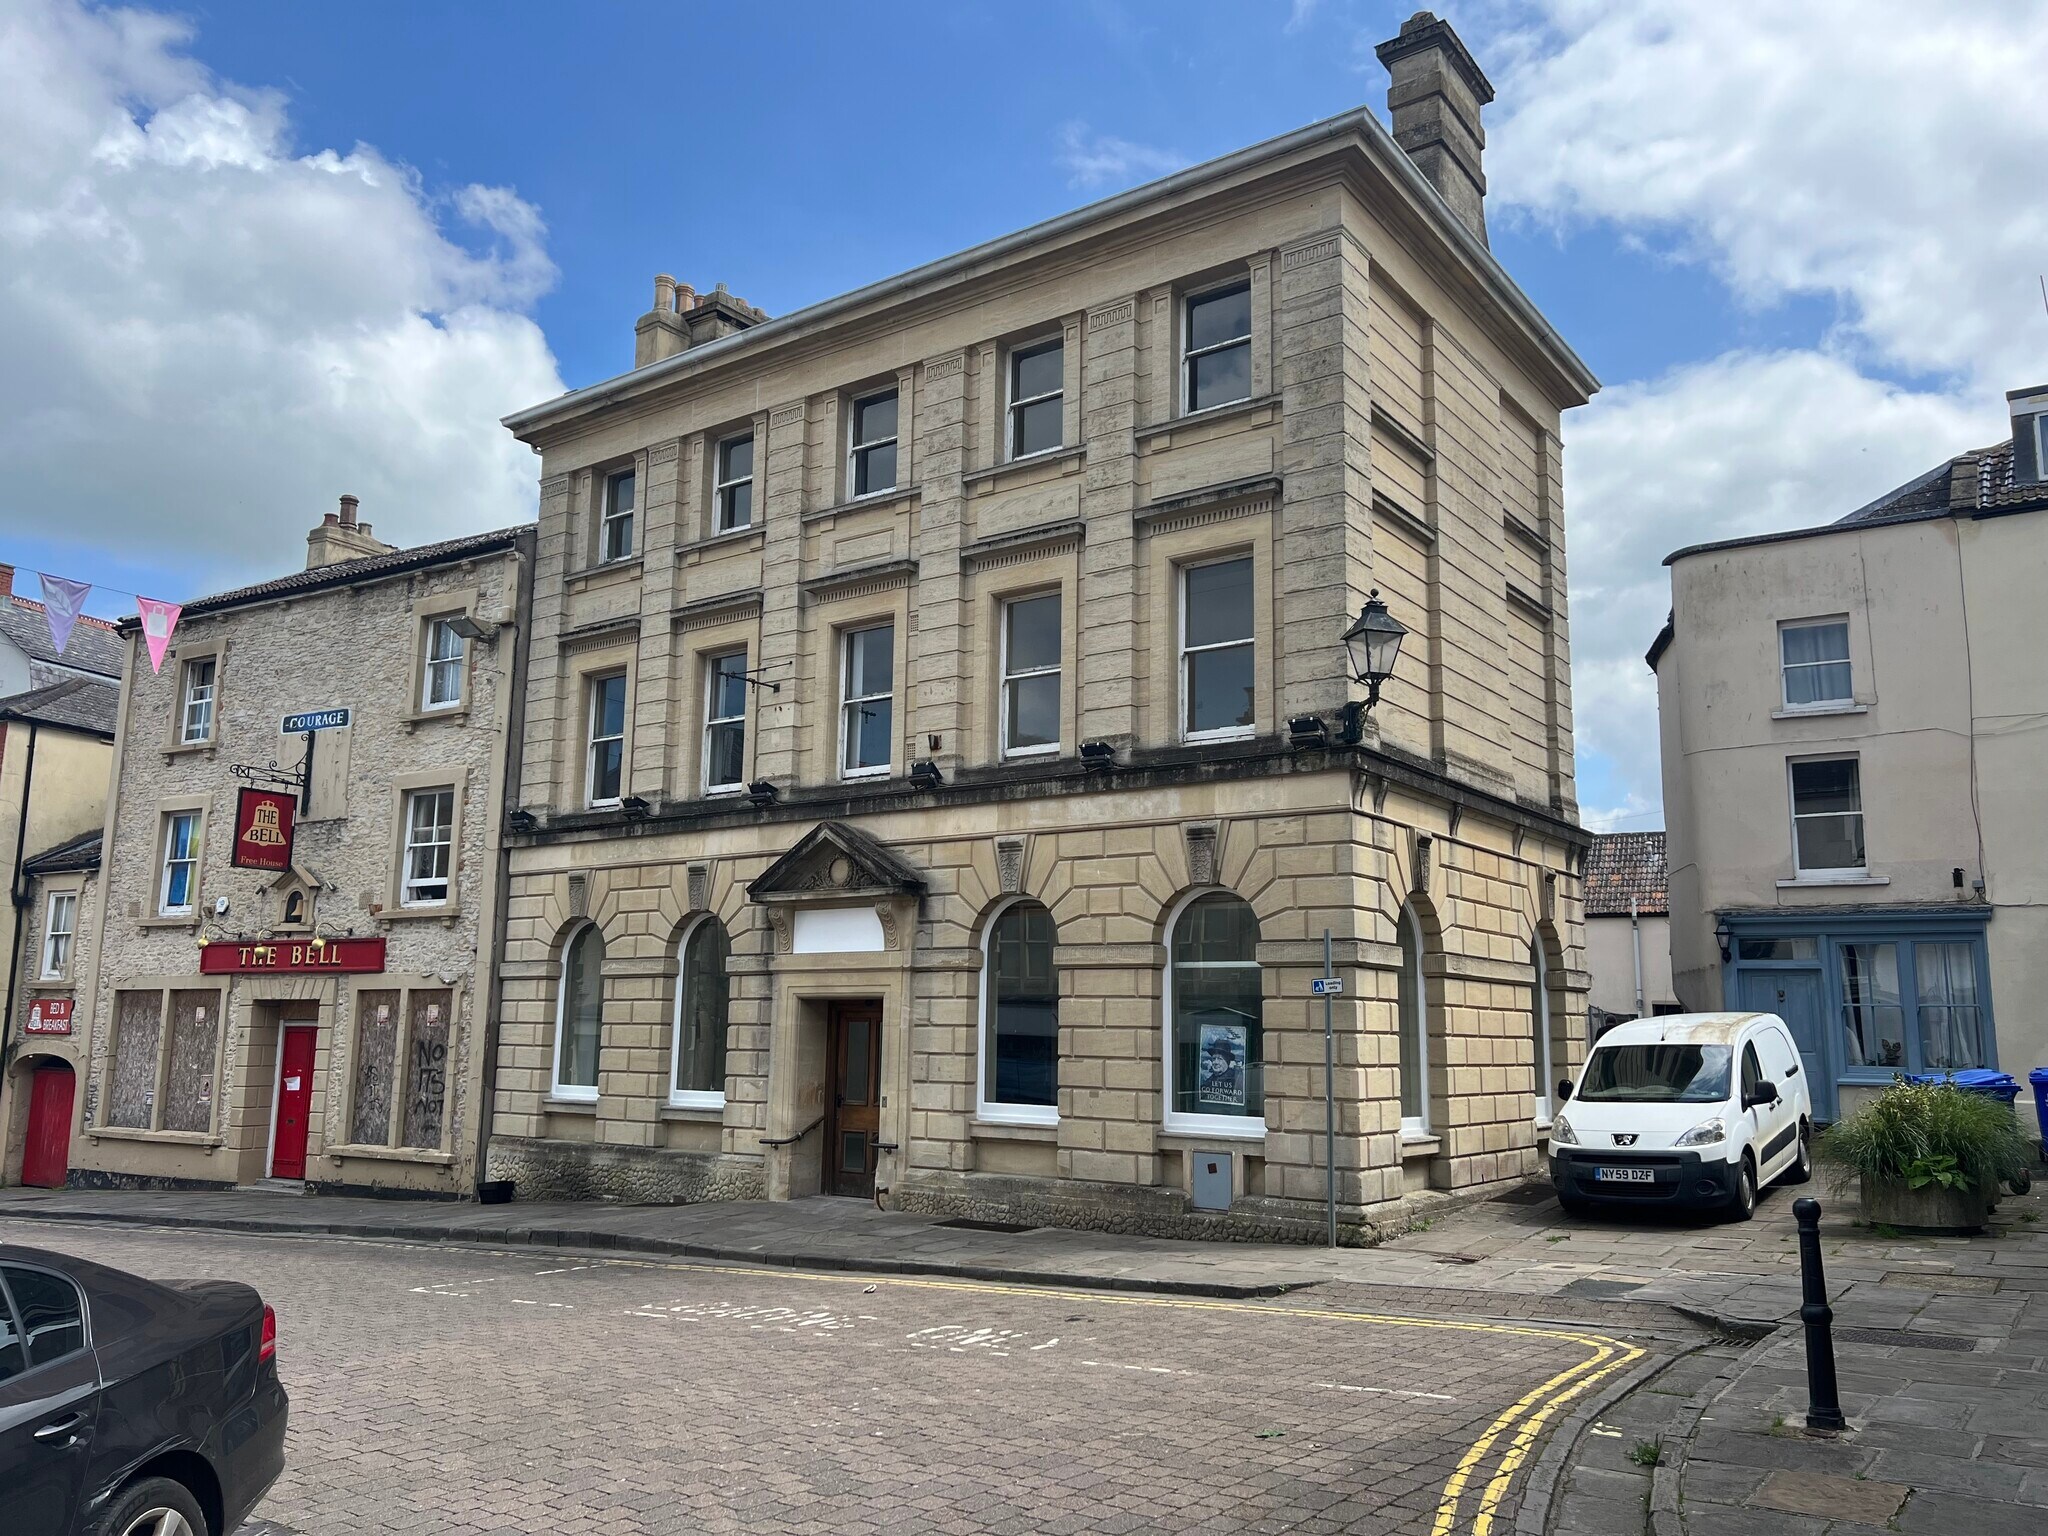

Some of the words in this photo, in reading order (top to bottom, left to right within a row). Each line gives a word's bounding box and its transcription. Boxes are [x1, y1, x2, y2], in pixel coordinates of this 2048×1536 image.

[290, 711, 344, 729] COURAGE
[257, 808, 277, 824] THE
[249, 828, 282, 843] BELL
[240, 855, 257, 865] Free
[259, 857, 284, 868] House
[291, 944, 342, 965] BELL
[50, 1002, 60, 1014] BED
[42, 1019, 69, 1030] BREAKFAST
[418, 1040, 445, 1067] NO
[1207, 1094, 1238, 1102] TOGETHER
[1601, 1169, 1629, 1180] NY59
[1631, 1170, 1652, 1181] DZF
